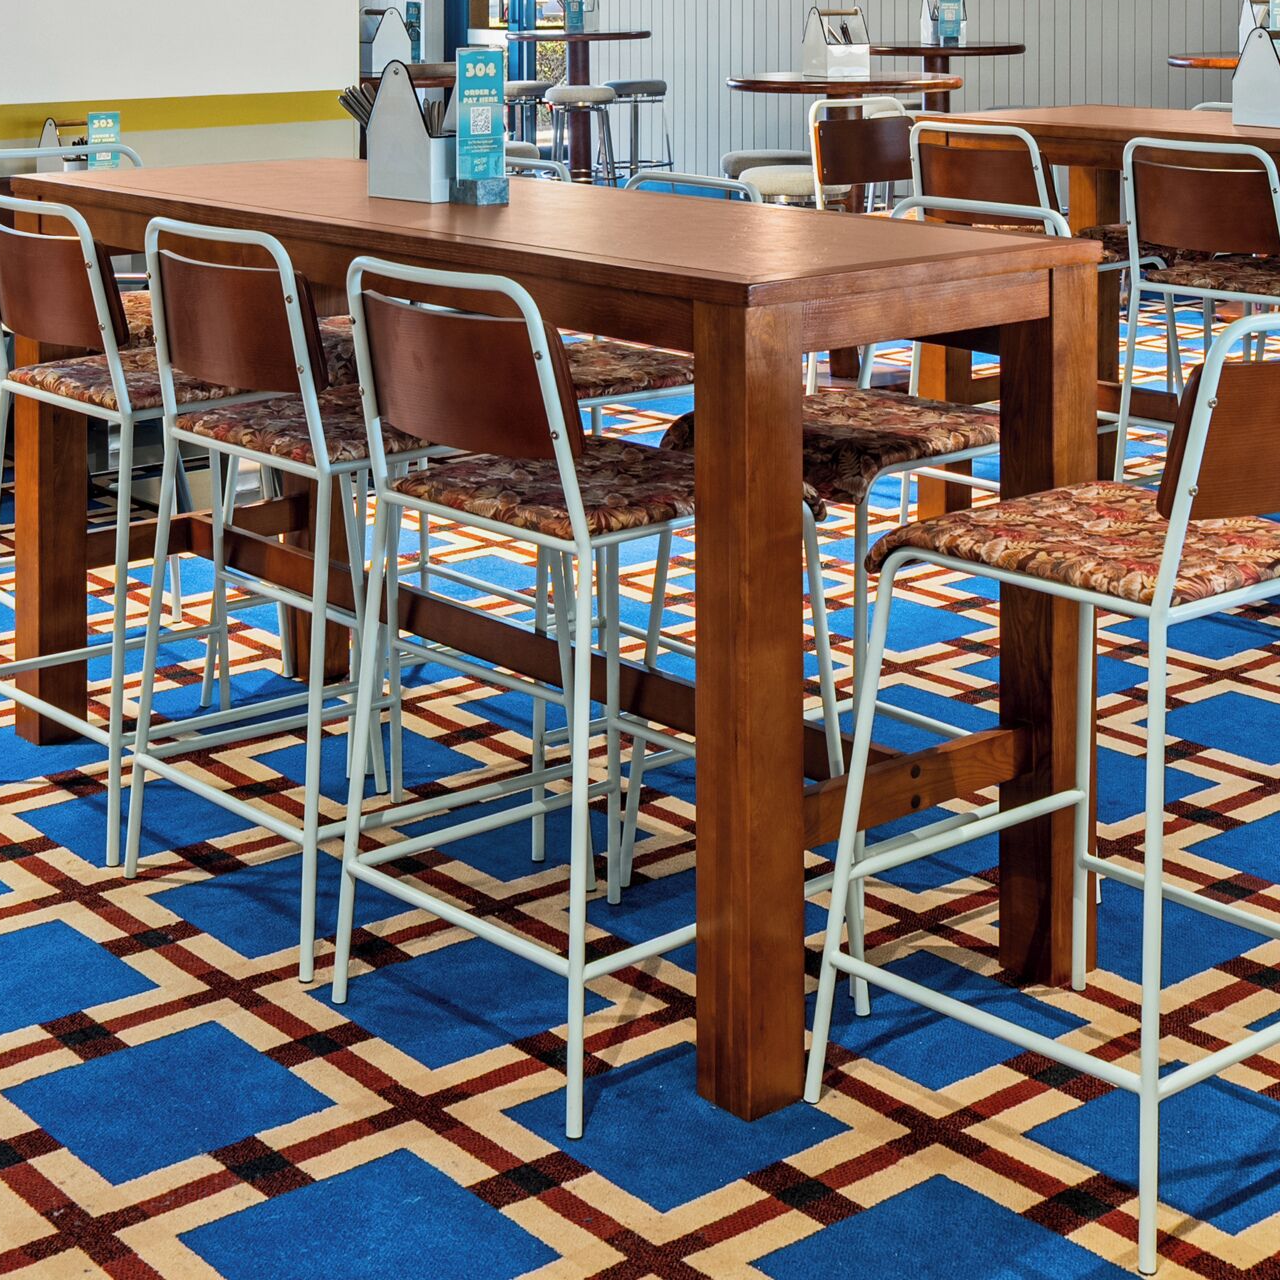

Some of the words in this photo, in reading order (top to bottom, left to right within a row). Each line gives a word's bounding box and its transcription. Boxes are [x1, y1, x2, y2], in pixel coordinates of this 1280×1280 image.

[465, 62, 496, 78] 304
[464, 88, 490, 96] ORDER
[92, 118, 114, 128] 303
